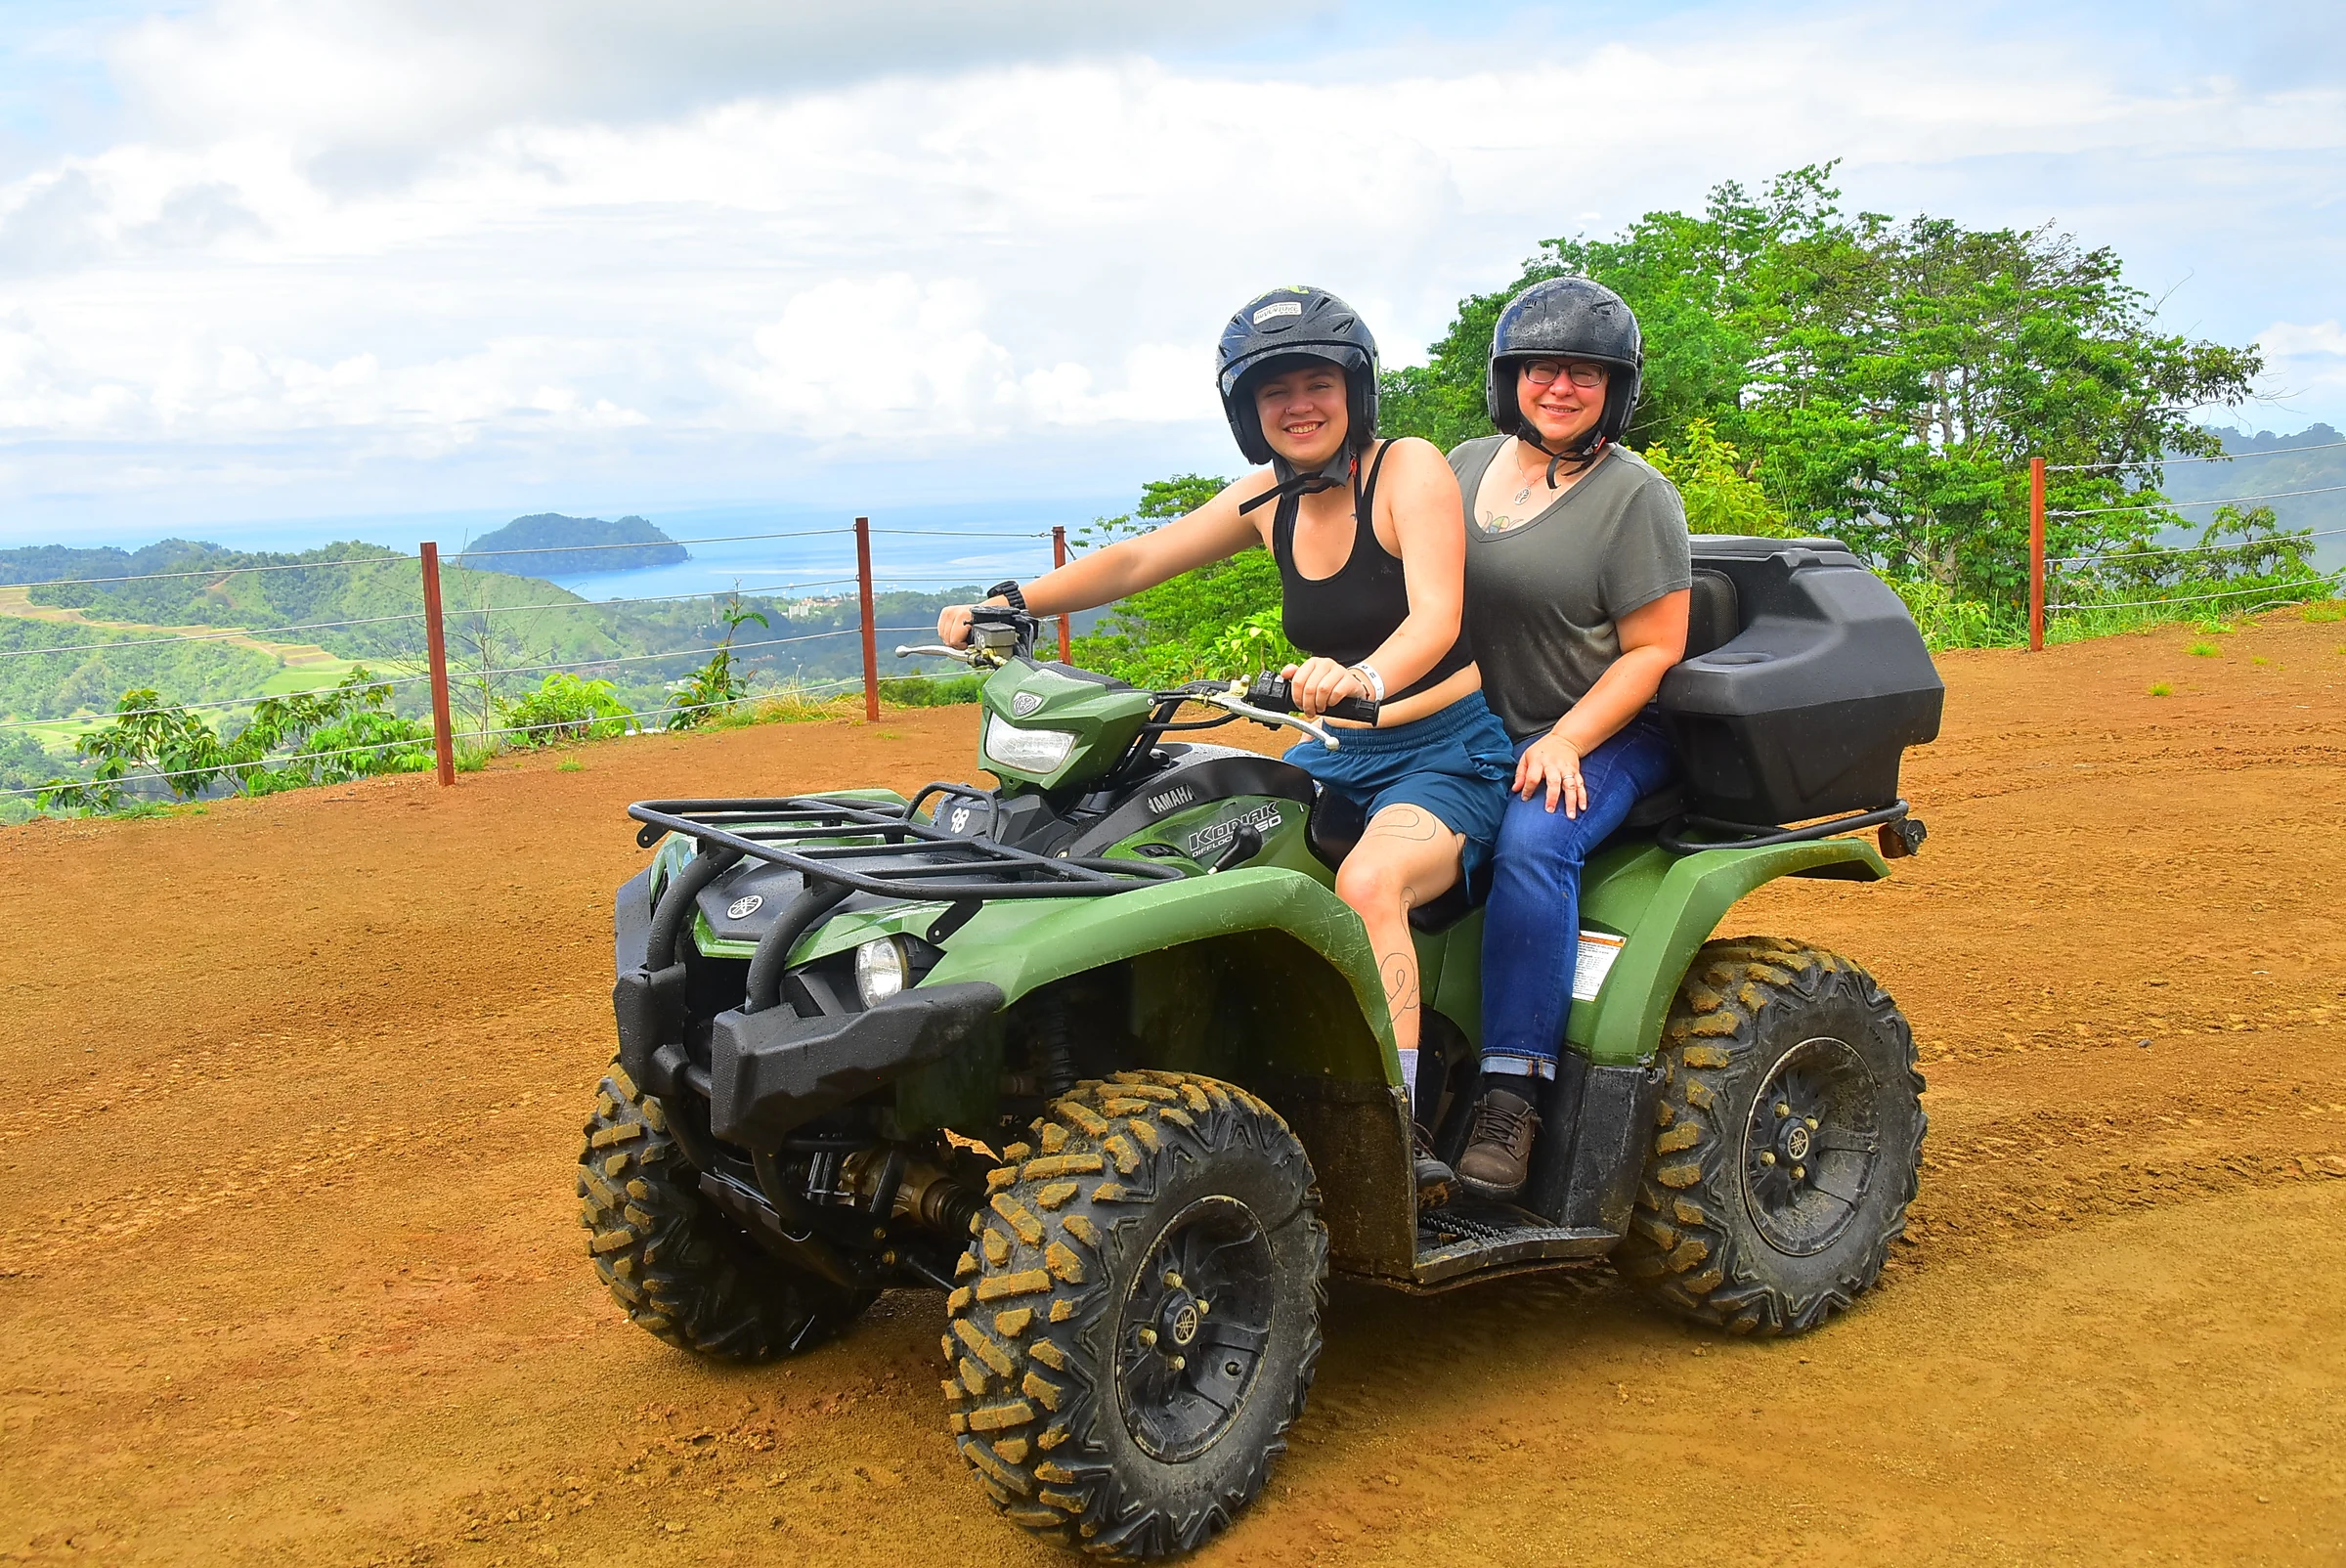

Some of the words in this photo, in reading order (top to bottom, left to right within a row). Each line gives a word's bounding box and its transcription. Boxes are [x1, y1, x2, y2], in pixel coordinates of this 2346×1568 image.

[976, 631, 985, 649] 98
[1148, 784, 1196, 813] YAMAHA
[951, 807, 970, 834] 98
[1189, 802, 1279, 851] KODIAK
